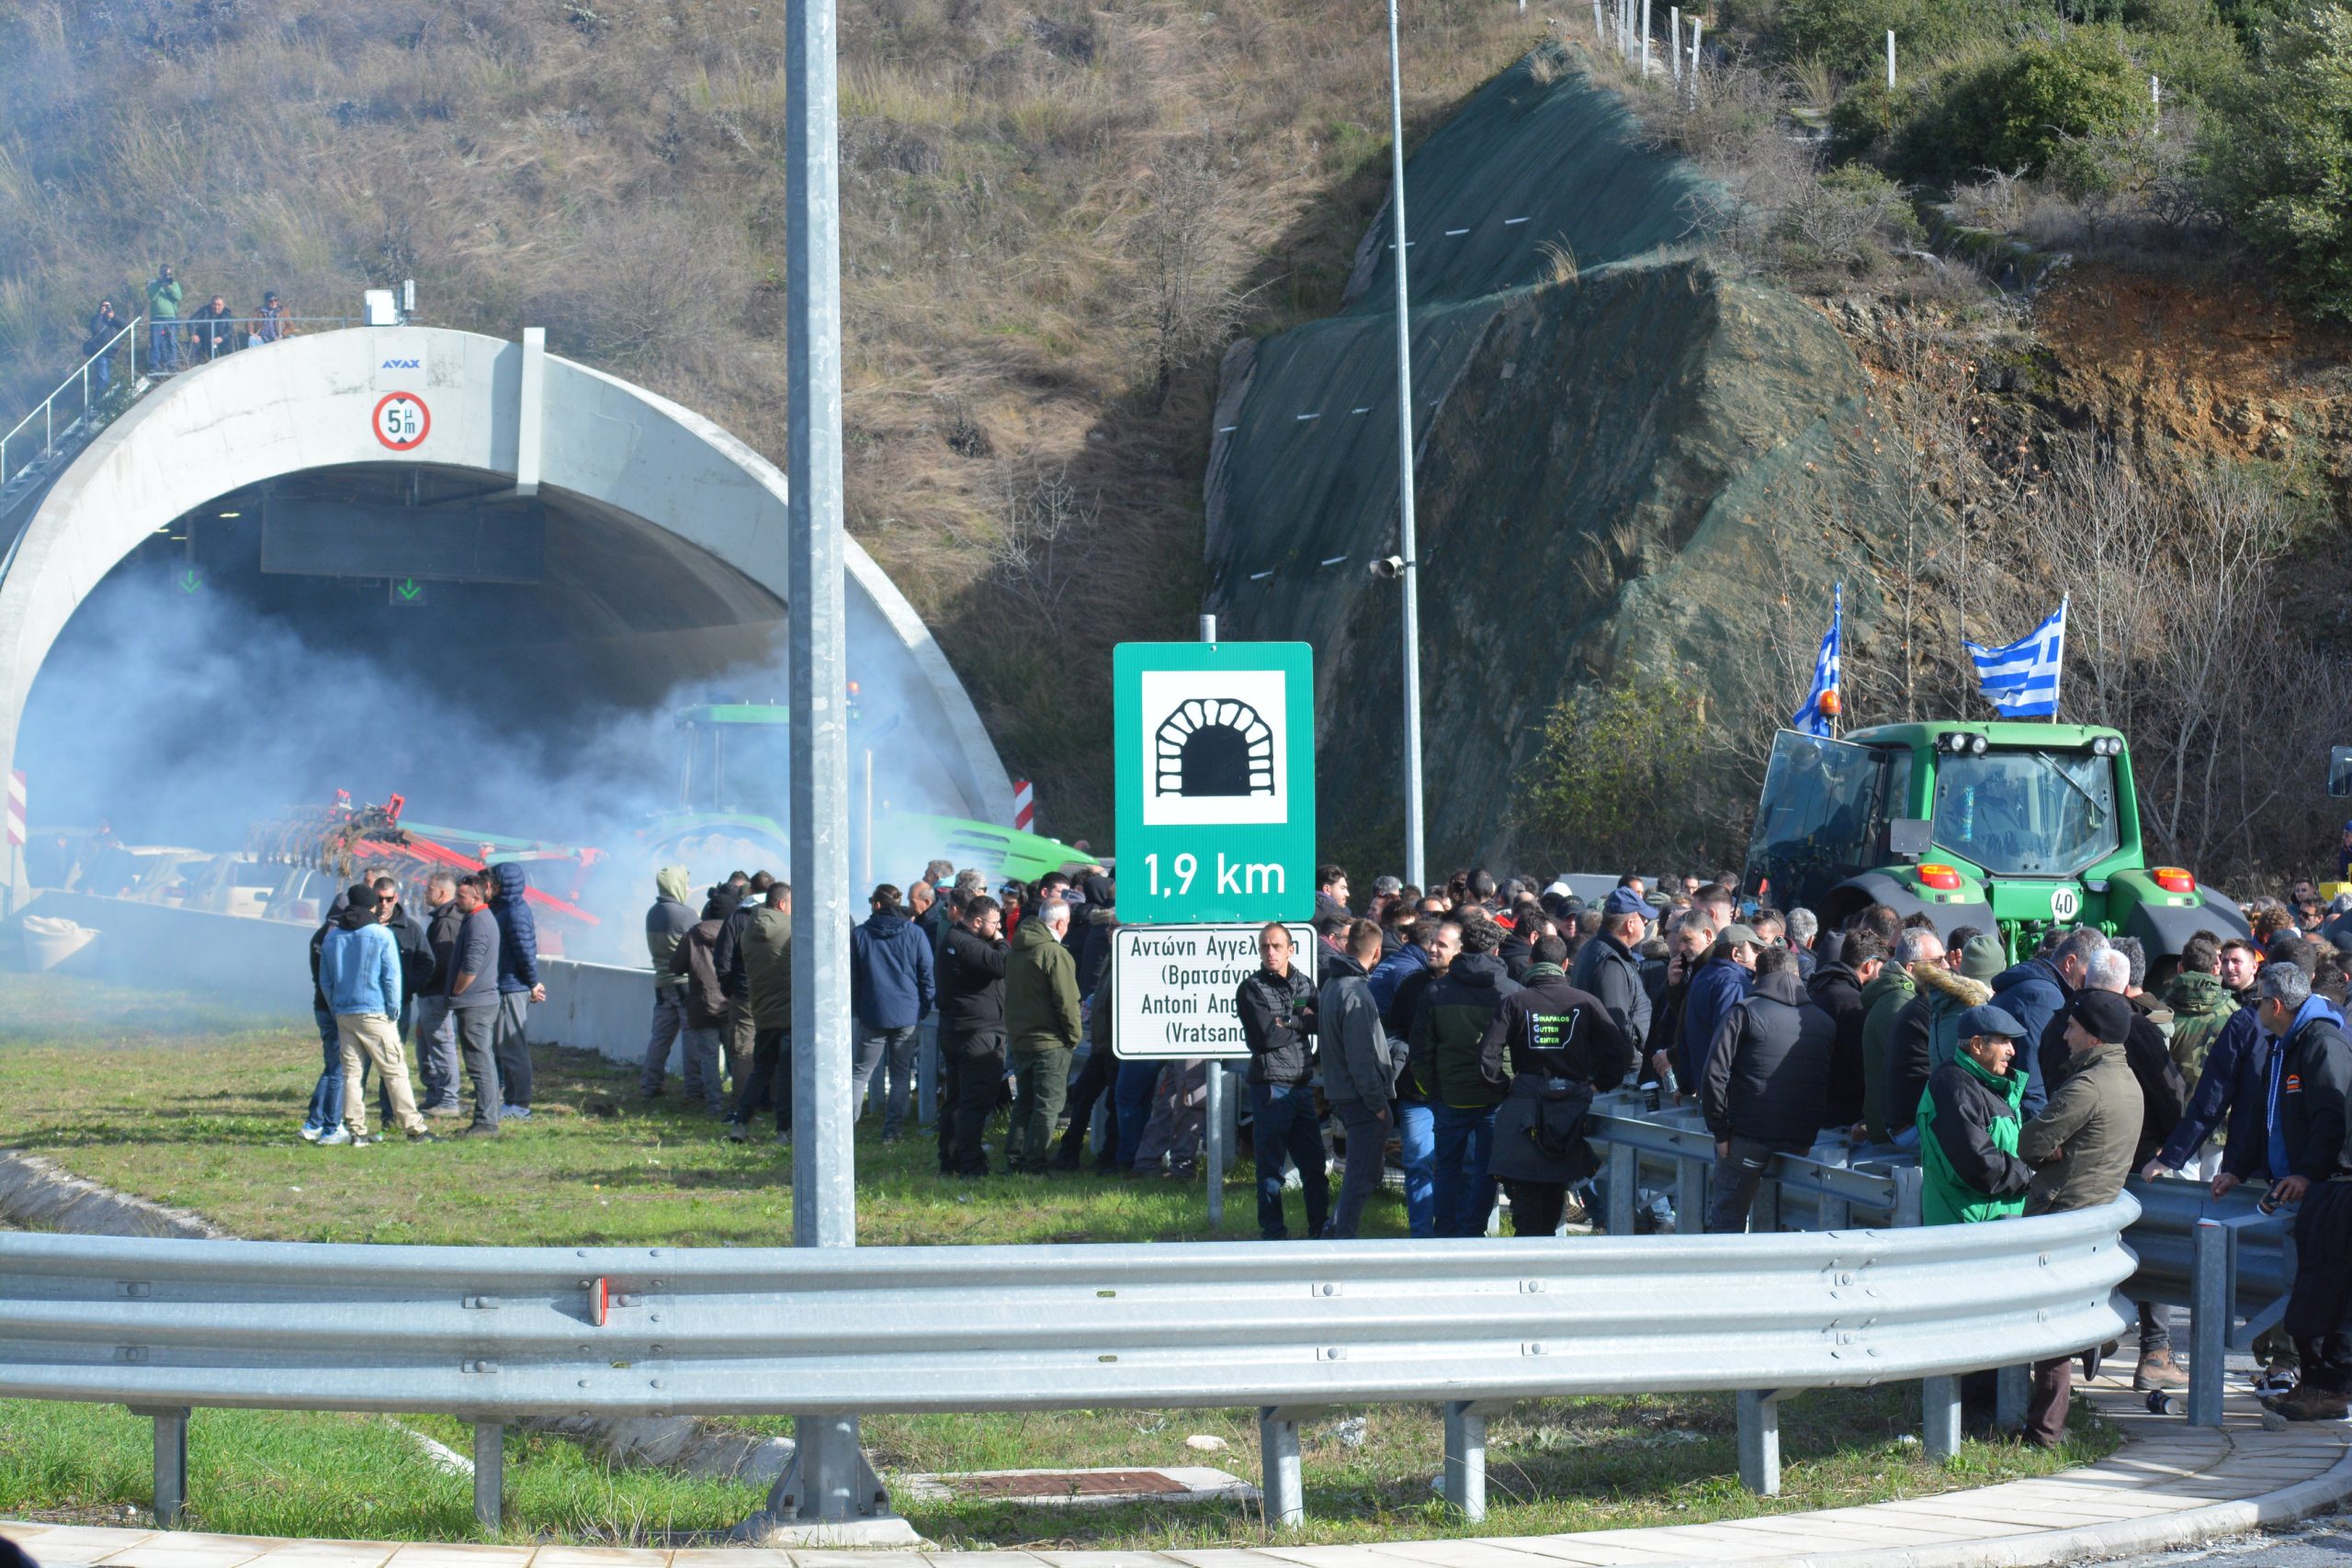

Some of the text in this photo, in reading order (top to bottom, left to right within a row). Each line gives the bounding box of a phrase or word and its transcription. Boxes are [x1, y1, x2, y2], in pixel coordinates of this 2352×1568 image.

[382, 359, 421, 368] AVAX
[388, 410, 401, 434] 5
[1145, 852, 1285, 899] 1,9 km
[2054, 893, 2073, 914] 40
[1131, 935, 1300, 962] Αντώνη Αγγελη
[1141, 993, 1197, 1014] Antoni
[1166, 1021, 1248, 1044] (Vratsano
[1534, 1035, 1560, 1043] CENTER
